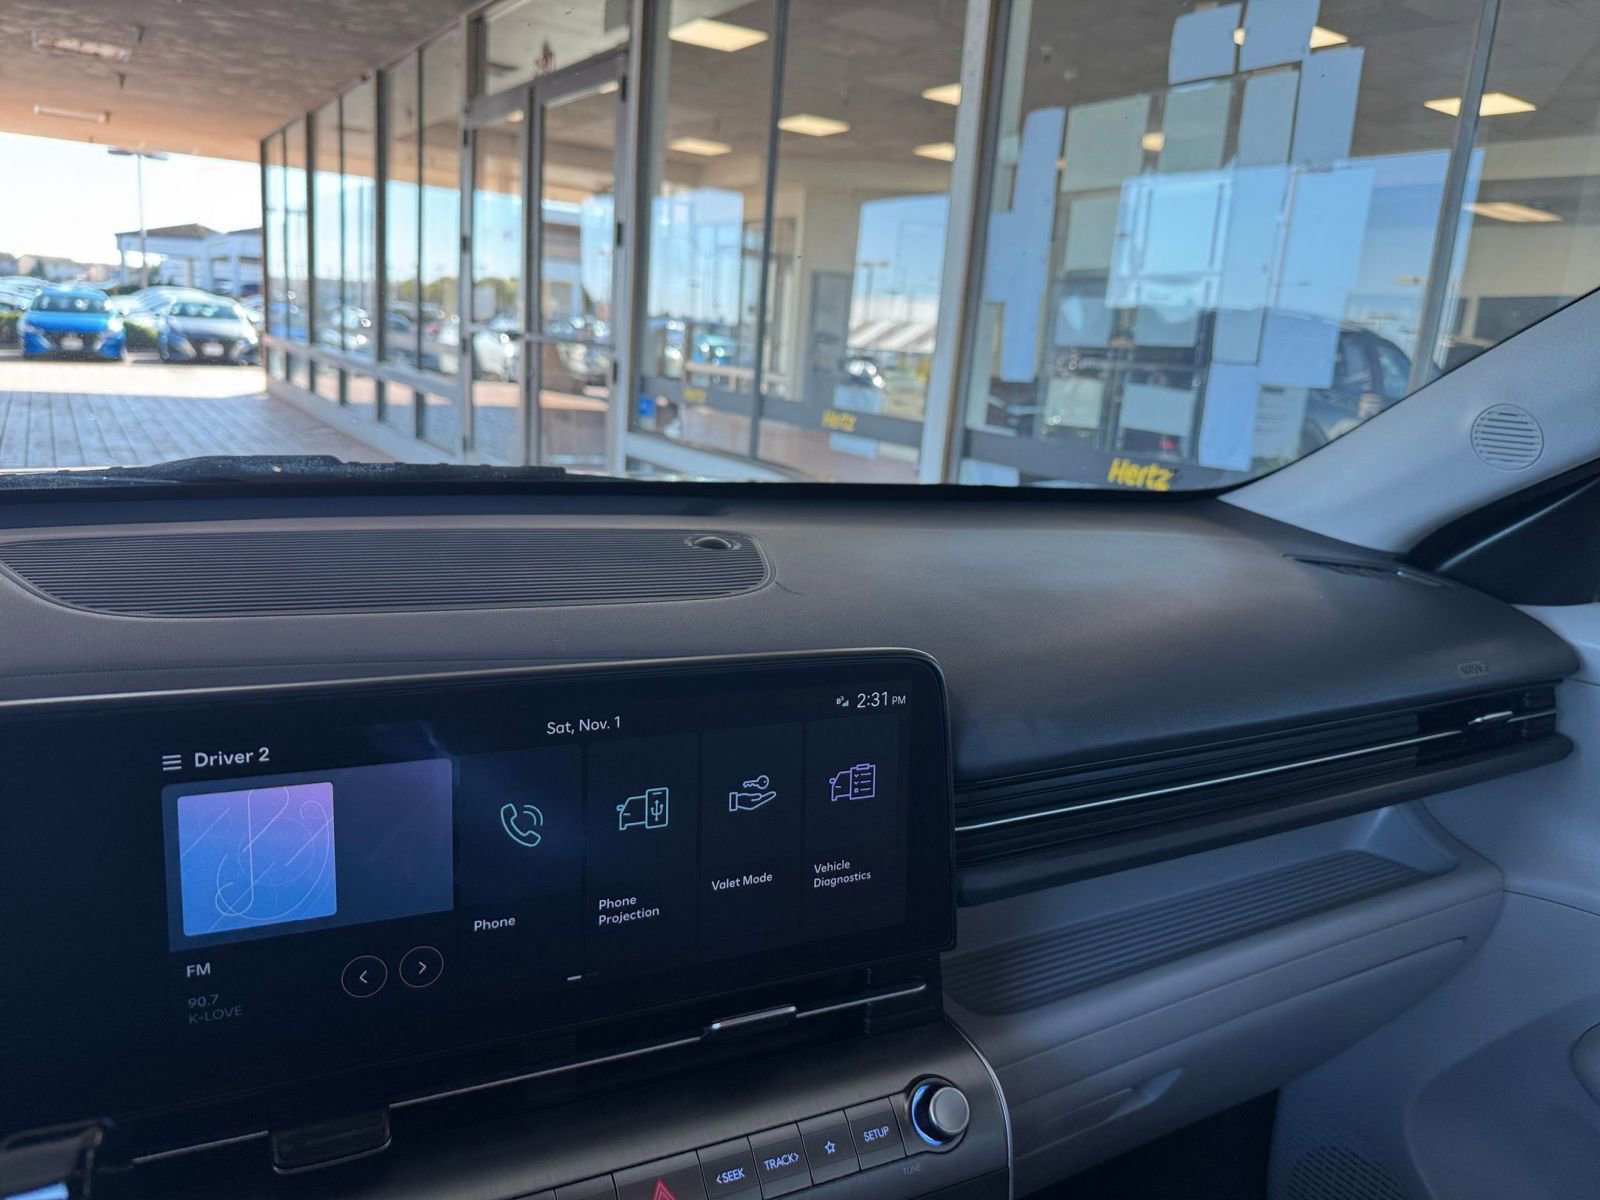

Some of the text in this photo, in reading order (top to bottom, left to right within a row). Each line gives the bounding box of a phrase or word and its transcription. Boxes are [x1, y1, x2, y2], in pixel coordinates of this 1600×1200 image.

[1107, 457, 1173, 491] Hertz
[857, 691, 906, 708] 2:31 PM
[546, 715, 621, 735] Sat, Nov. 1
[194, 746, 270, 768] Driver 2
[813, 860, 851, 874] Vehicle
[711, 872, 773, 891] Valet Mode
[813, 871, 872, 889] Diagnostics
[598, 896, 637, 910] Phone
[474, 916, 516, 931] Phone
[598, 906, 660, 925] Projection
[186, 962, 211, 978] FM
[188, 993, 219, 1009] 90.7
[188, 1005, 244, 1024] K-LOVE
[863, 1126, 890, 1142] SETUP
